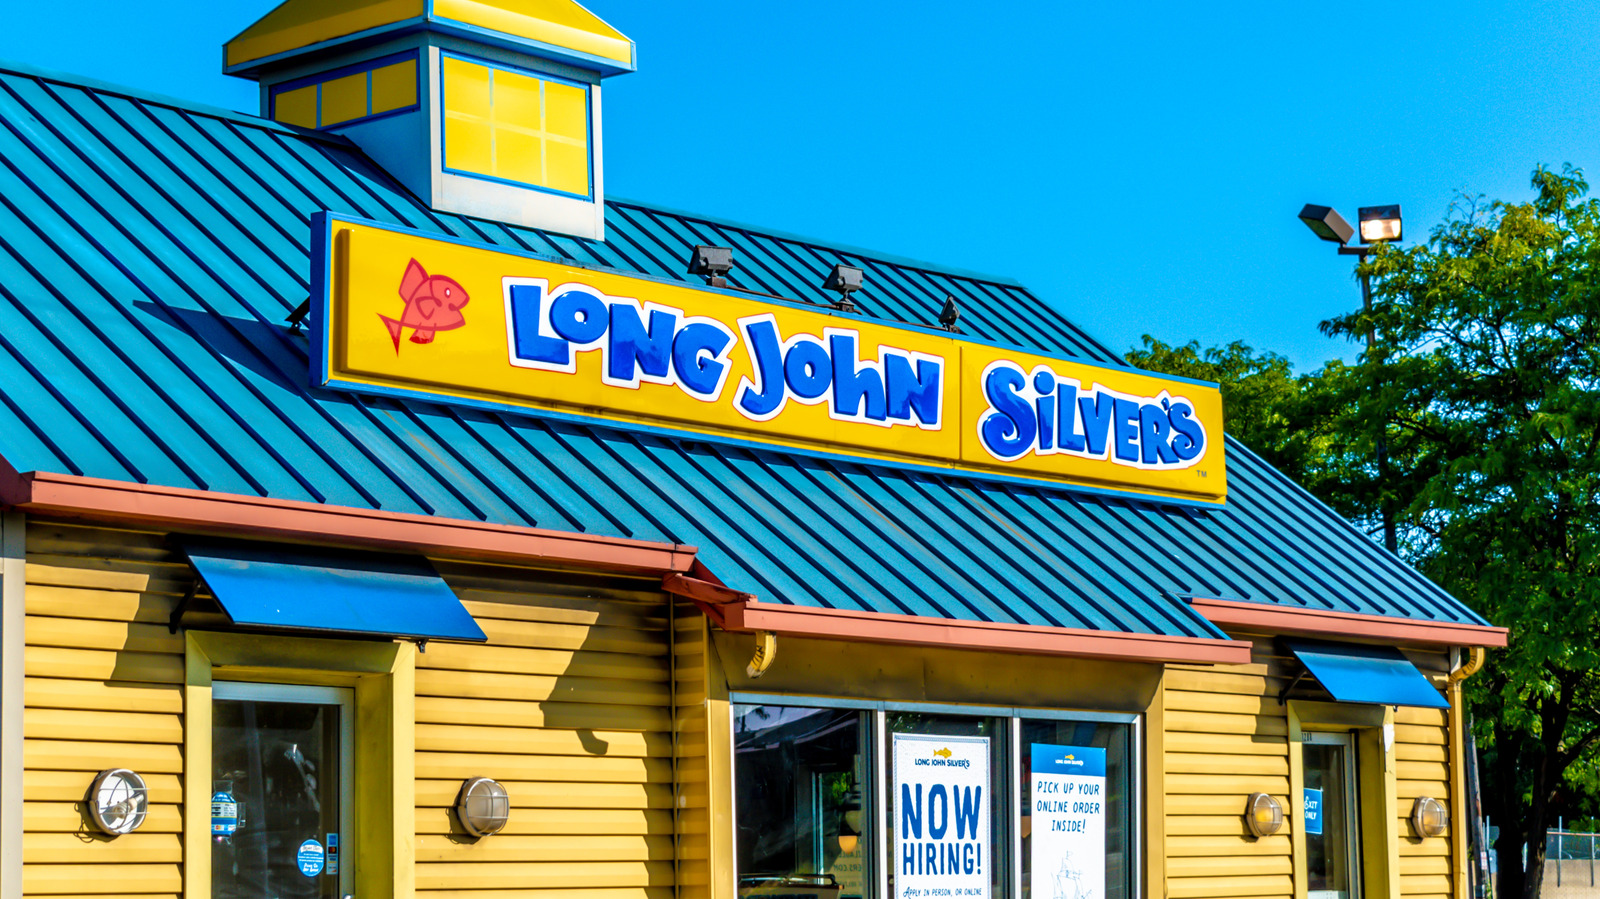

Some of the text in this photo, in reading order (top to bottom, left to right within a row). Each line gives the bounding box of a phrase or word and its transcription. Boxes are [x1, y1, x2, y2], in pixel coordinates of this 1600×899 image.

[506, 280, 734, 398] LONG
[1196, 469, 1207, 478] TM
[914, 758, 970, 770] LONG JOHN SILVER'S
[1037, 780, 1100, 795] PICK UP YOUR
[902, 783, 982, 840] NOW
[1036, 800, 1100, 814] ONLINE ORDER
[1305, 811, 1317, 820] ONLY
[1052, 818, 1086, 834] INSIDE!
[903, 842, 981, 876] HIRING!
[903, 886, 982, 899] APPLY IN PERSON, OR ONLINE
